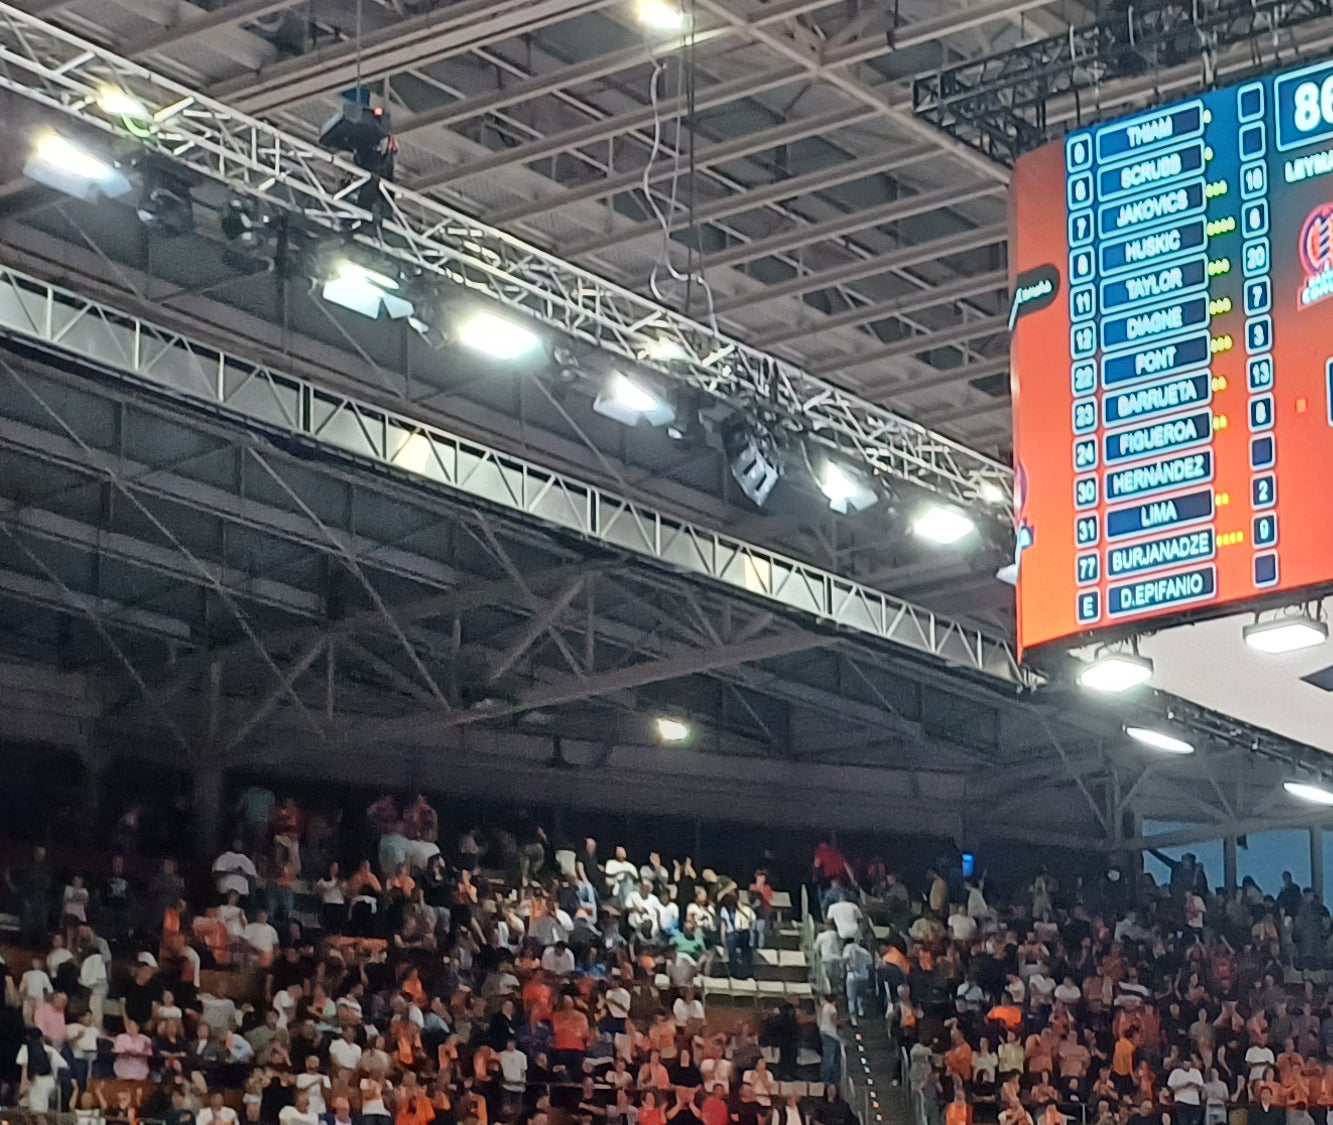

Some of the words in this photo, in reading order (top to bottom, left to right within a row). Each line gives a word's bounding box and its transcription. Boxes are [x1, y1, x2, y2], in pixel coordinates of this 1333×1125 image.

[1127, 116, 1173, 147] THIAM
[1121, 153, 1182, 189] SCRUBB
[1077, 217, 1087, 239] 7
[1117, 189, 1188, 227] JAKOVICS
[1125, 230, 1180, 262] HUSKIC
[1076, 292, 1090, 313] 11
[1125, 268, 1183, 300] TAYLOR
[1246, 245, 1265, 269] 20
[1076, 328, 1091, 350] 12
[1126, 306, 1183, 339] DIAGNE
[1252, 285, 1263, 308] 7
[1075, 366, 1094, 390] 22
[1135, 347, 1177, 375] FONT
[1253, 324, 1265, 347] 3
[1075, 403, 1094, 427] 23
[1117, 380, 1197, 417] BARRUETA
[1252, 364, 1270, 385] 13
[1077, 442, 1095, 465] 24
[1119, 419, 1197, 455] FIGUEROA
[1077, 480, 1095, 502] 30
[1078, 518, 1095, 539] 31
[1141, 500, 1178, 526] LIMA
[1258, 481, 1268, 502] 2
[1080, 557, 1095, 578] 77
[1112, 532, 1209, 571] BURJANADZE
[1083, 597, 1094, 616] E
[1120, 572, 1203, 609] D.EPIFANIO
